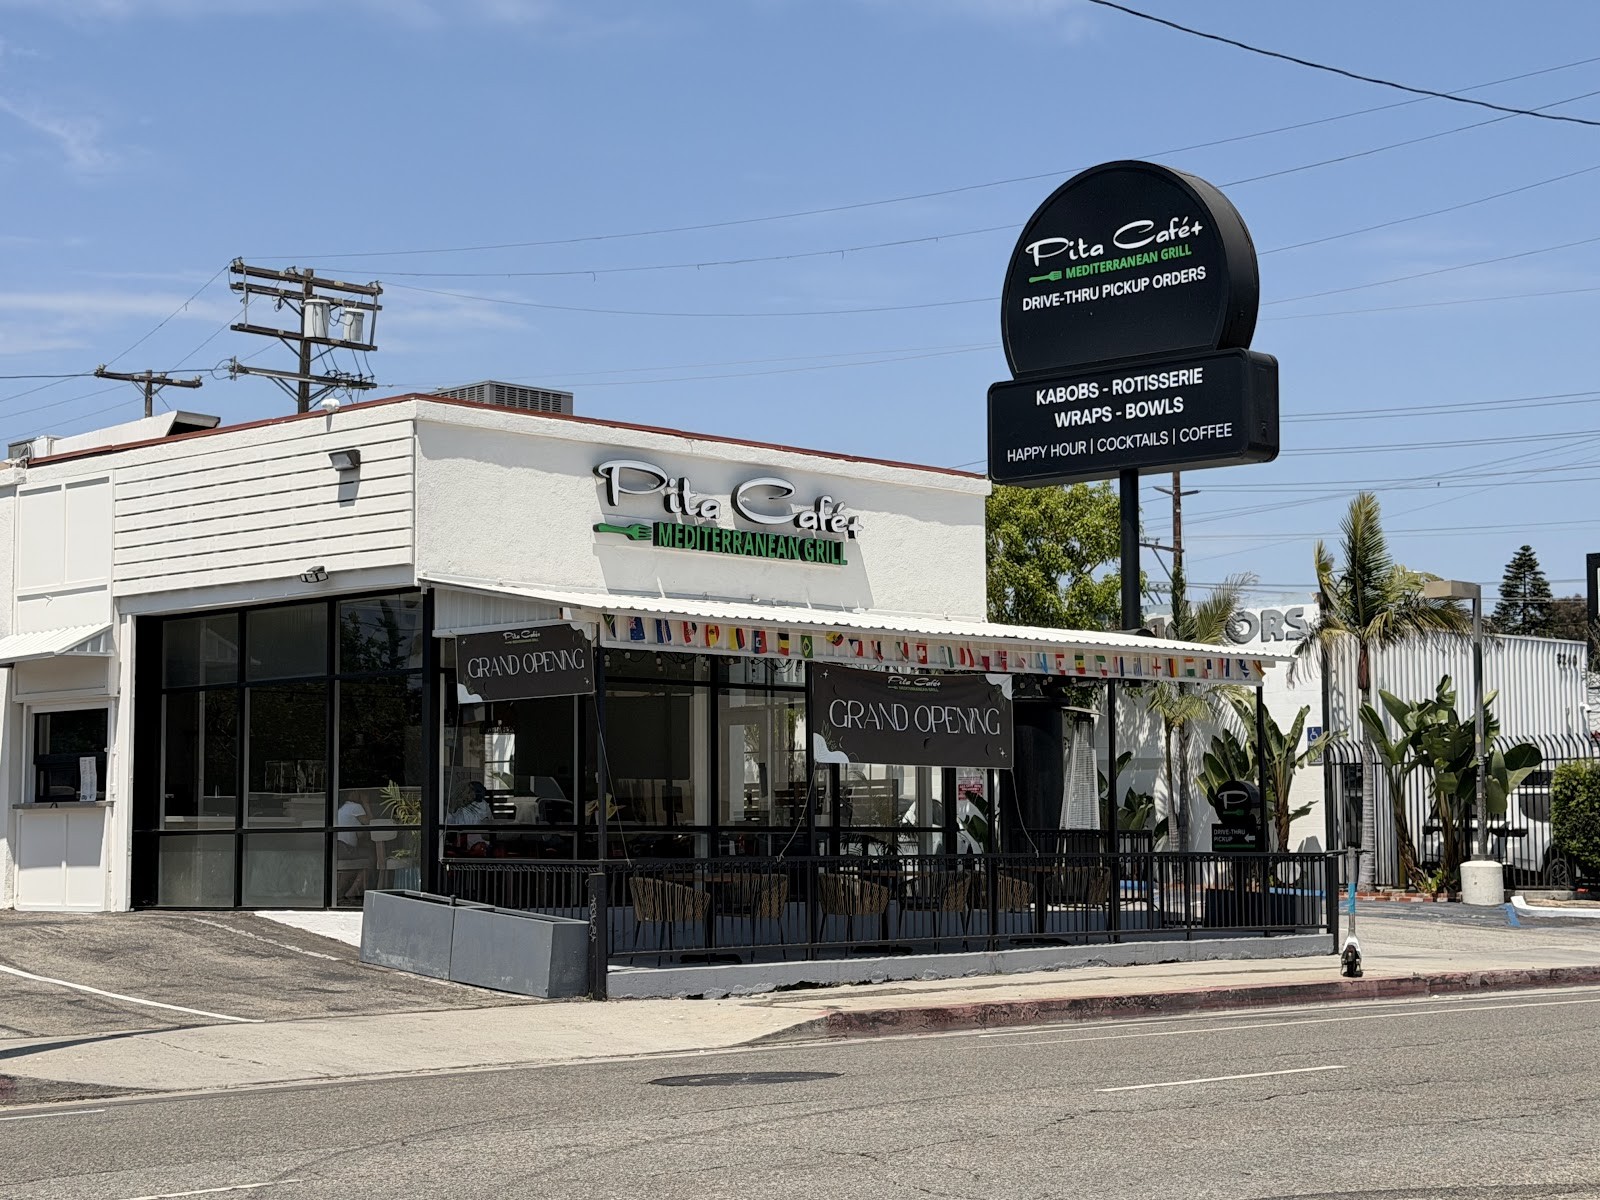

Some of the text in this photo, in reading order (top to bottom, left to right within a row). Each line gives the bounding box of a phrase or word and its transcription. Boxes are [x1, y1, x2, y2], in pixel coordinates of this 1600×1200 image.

[1025, 237, 1104, 267] Pita
[1066, 243, 1192, 279] MEDITERRANEAN GRILL
[1022, 265, 1207, 312] DRIVE-THRU PICKUP ORDERS
[1036, 382, 1099, 406] KABOBS
[1112, 367, 1204, 396] ROTISSERIE
[1055, 405, 1112, 428] WRAPS
[1126, 396, 1184, 420] BOWLS
[1007, 444, 1047, 462] HAPPY
[1050, 440, 1087, 458] HOUR
[1097, 431, 1169, 452] COCKTAILS
[1179, 422, 1233, 443] COFFEE
[592, 459, 721, 519] Pita
[653, 522, 848, 565] MEDITERRANEAN GRILL
[467, 648, 585, 679] GRAND OPENING
[829, 699, 1000, 736] GRAND OPENING
